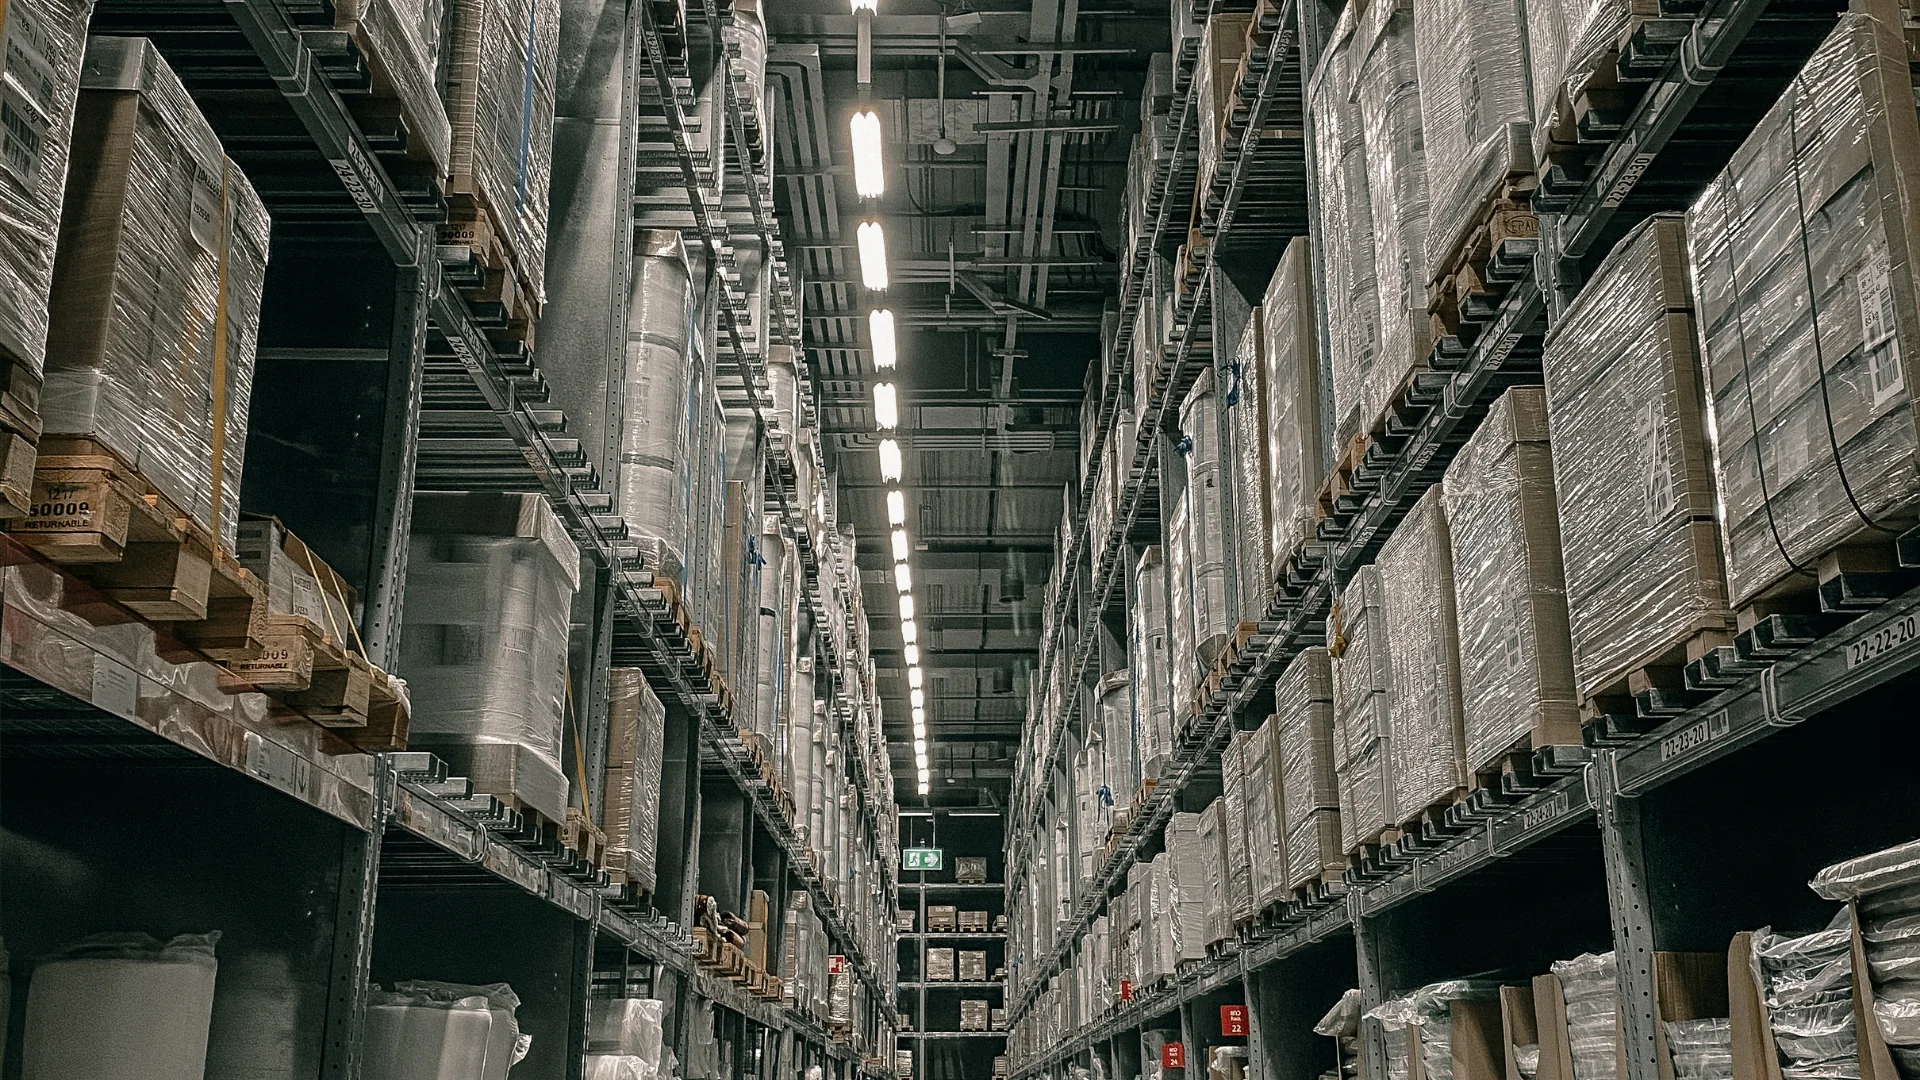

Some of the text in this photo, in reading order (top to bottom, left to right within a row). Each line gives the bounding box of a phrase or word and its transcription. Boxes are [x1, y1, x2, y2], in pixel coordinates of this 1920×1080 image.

[333, 164, 376, 209] 24-23-30
[1605, 157, 1651, 203] 22-23-30
[448, 339, 480, 370] 24-24-30
[1486, 336, 1519, 367] 22-24-30
[29, 501, 90, 517] 50009
[24, 519, 90, 529] RETURNABLE
[1852, 616, 1916, 666] 22-22-20
[240, 662, 290, 670] RETURNABLE
[1665, 724, 1705, 759] 22-23-20
[1526, 802, 1553, 828] 22-24-20
[1231, 1024, 1242, 1033] 22
[1170, 1058, 1178, 1066] 24
